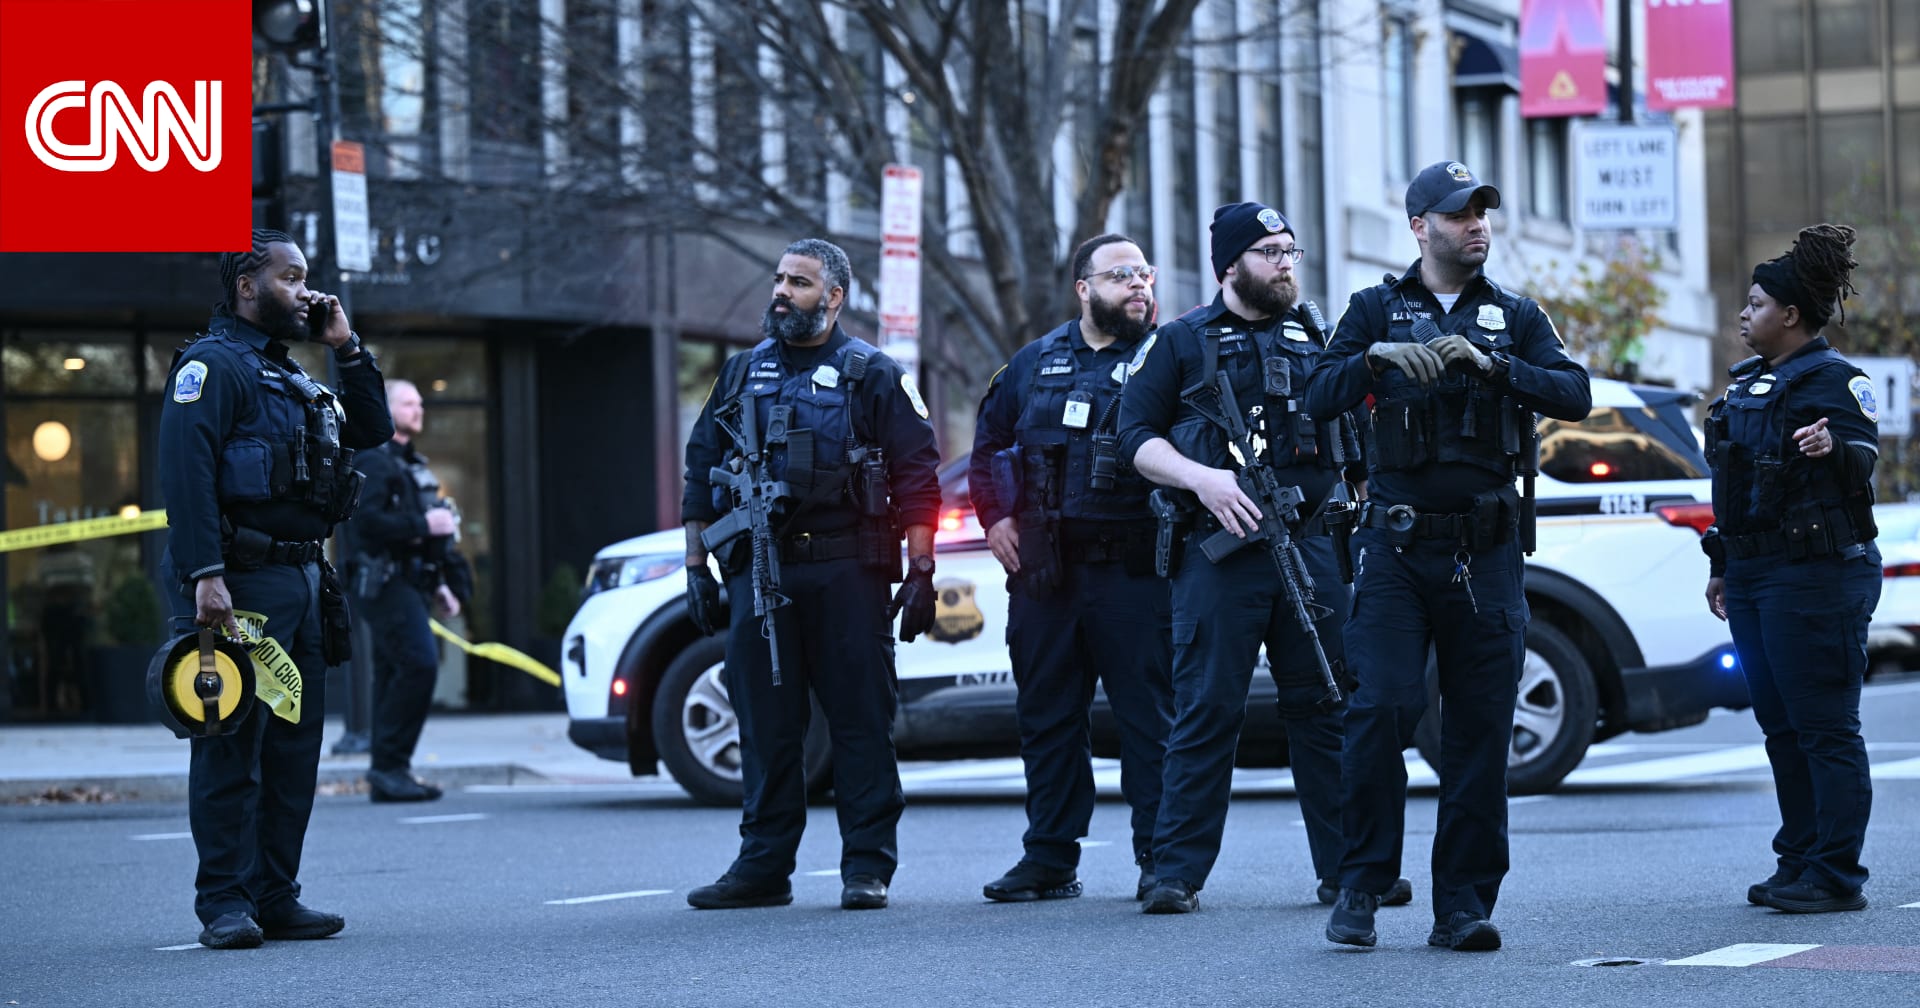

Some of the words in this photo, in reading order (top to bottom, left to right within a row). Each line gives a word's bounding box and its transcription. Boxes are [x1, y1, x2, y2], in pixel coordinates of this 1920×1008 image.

[1585, 138, 1622, 155] LEFT
[1627, 137, 1666, 154] LANE
[1598, 167, 1653, 185] MUST
[1585, 200, 1624, 214] TURN
[1632, 199, 1668, 214] LEFT
[1599, 495, 1646, 513] 4143
